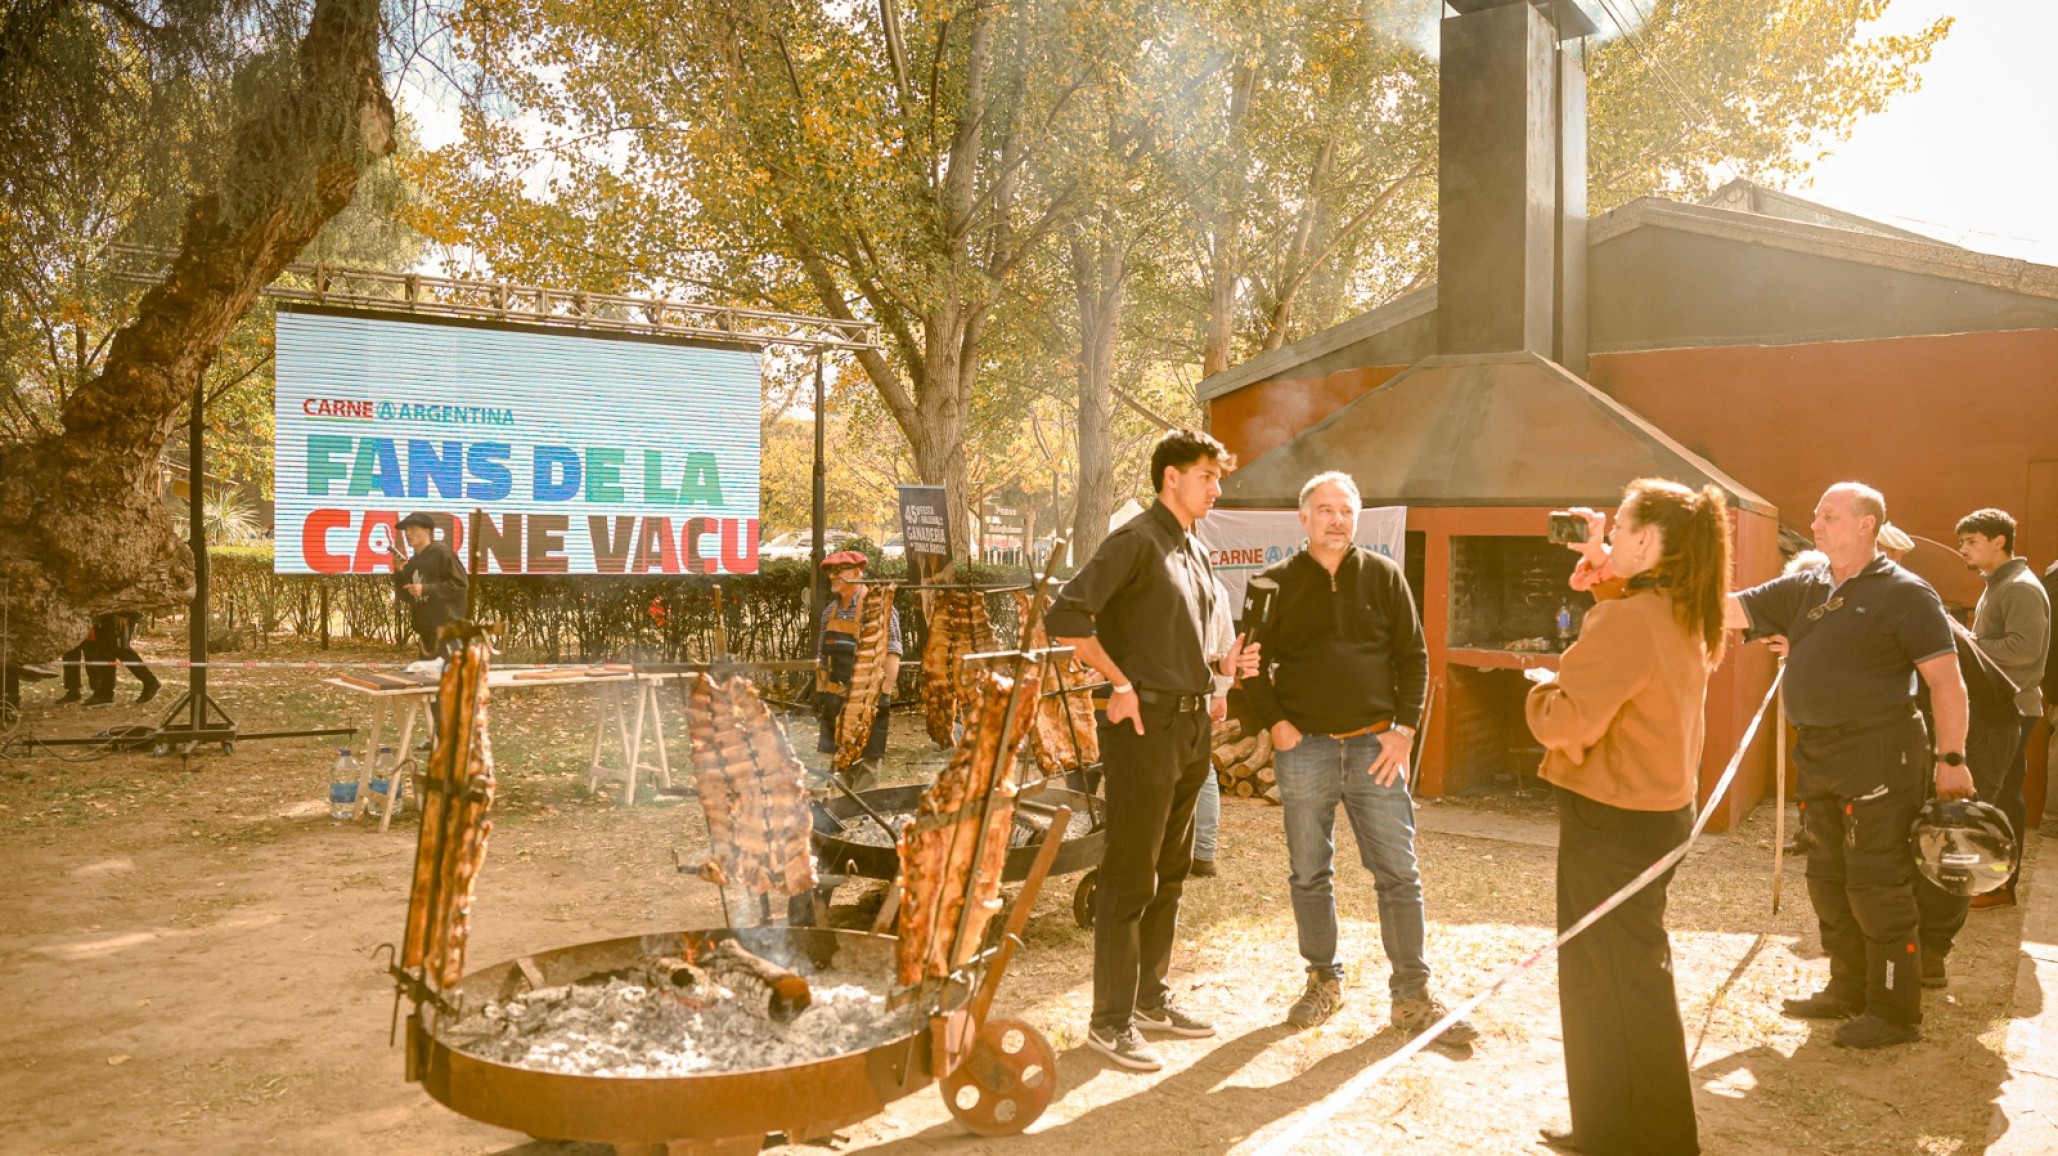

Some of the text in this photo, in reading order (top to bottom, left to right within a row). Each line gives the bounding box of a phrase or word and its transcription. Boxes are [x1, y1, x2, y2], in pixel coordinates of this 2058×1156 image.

[303, 398, 374, 418] CARNE
[399, 403, 515, 425] ARGENTINA
[306, 434, 725, 507] FANS DE LA
[588, 514, 760, 574] VACU
[1209, 548, 1264, 565] CARNE
